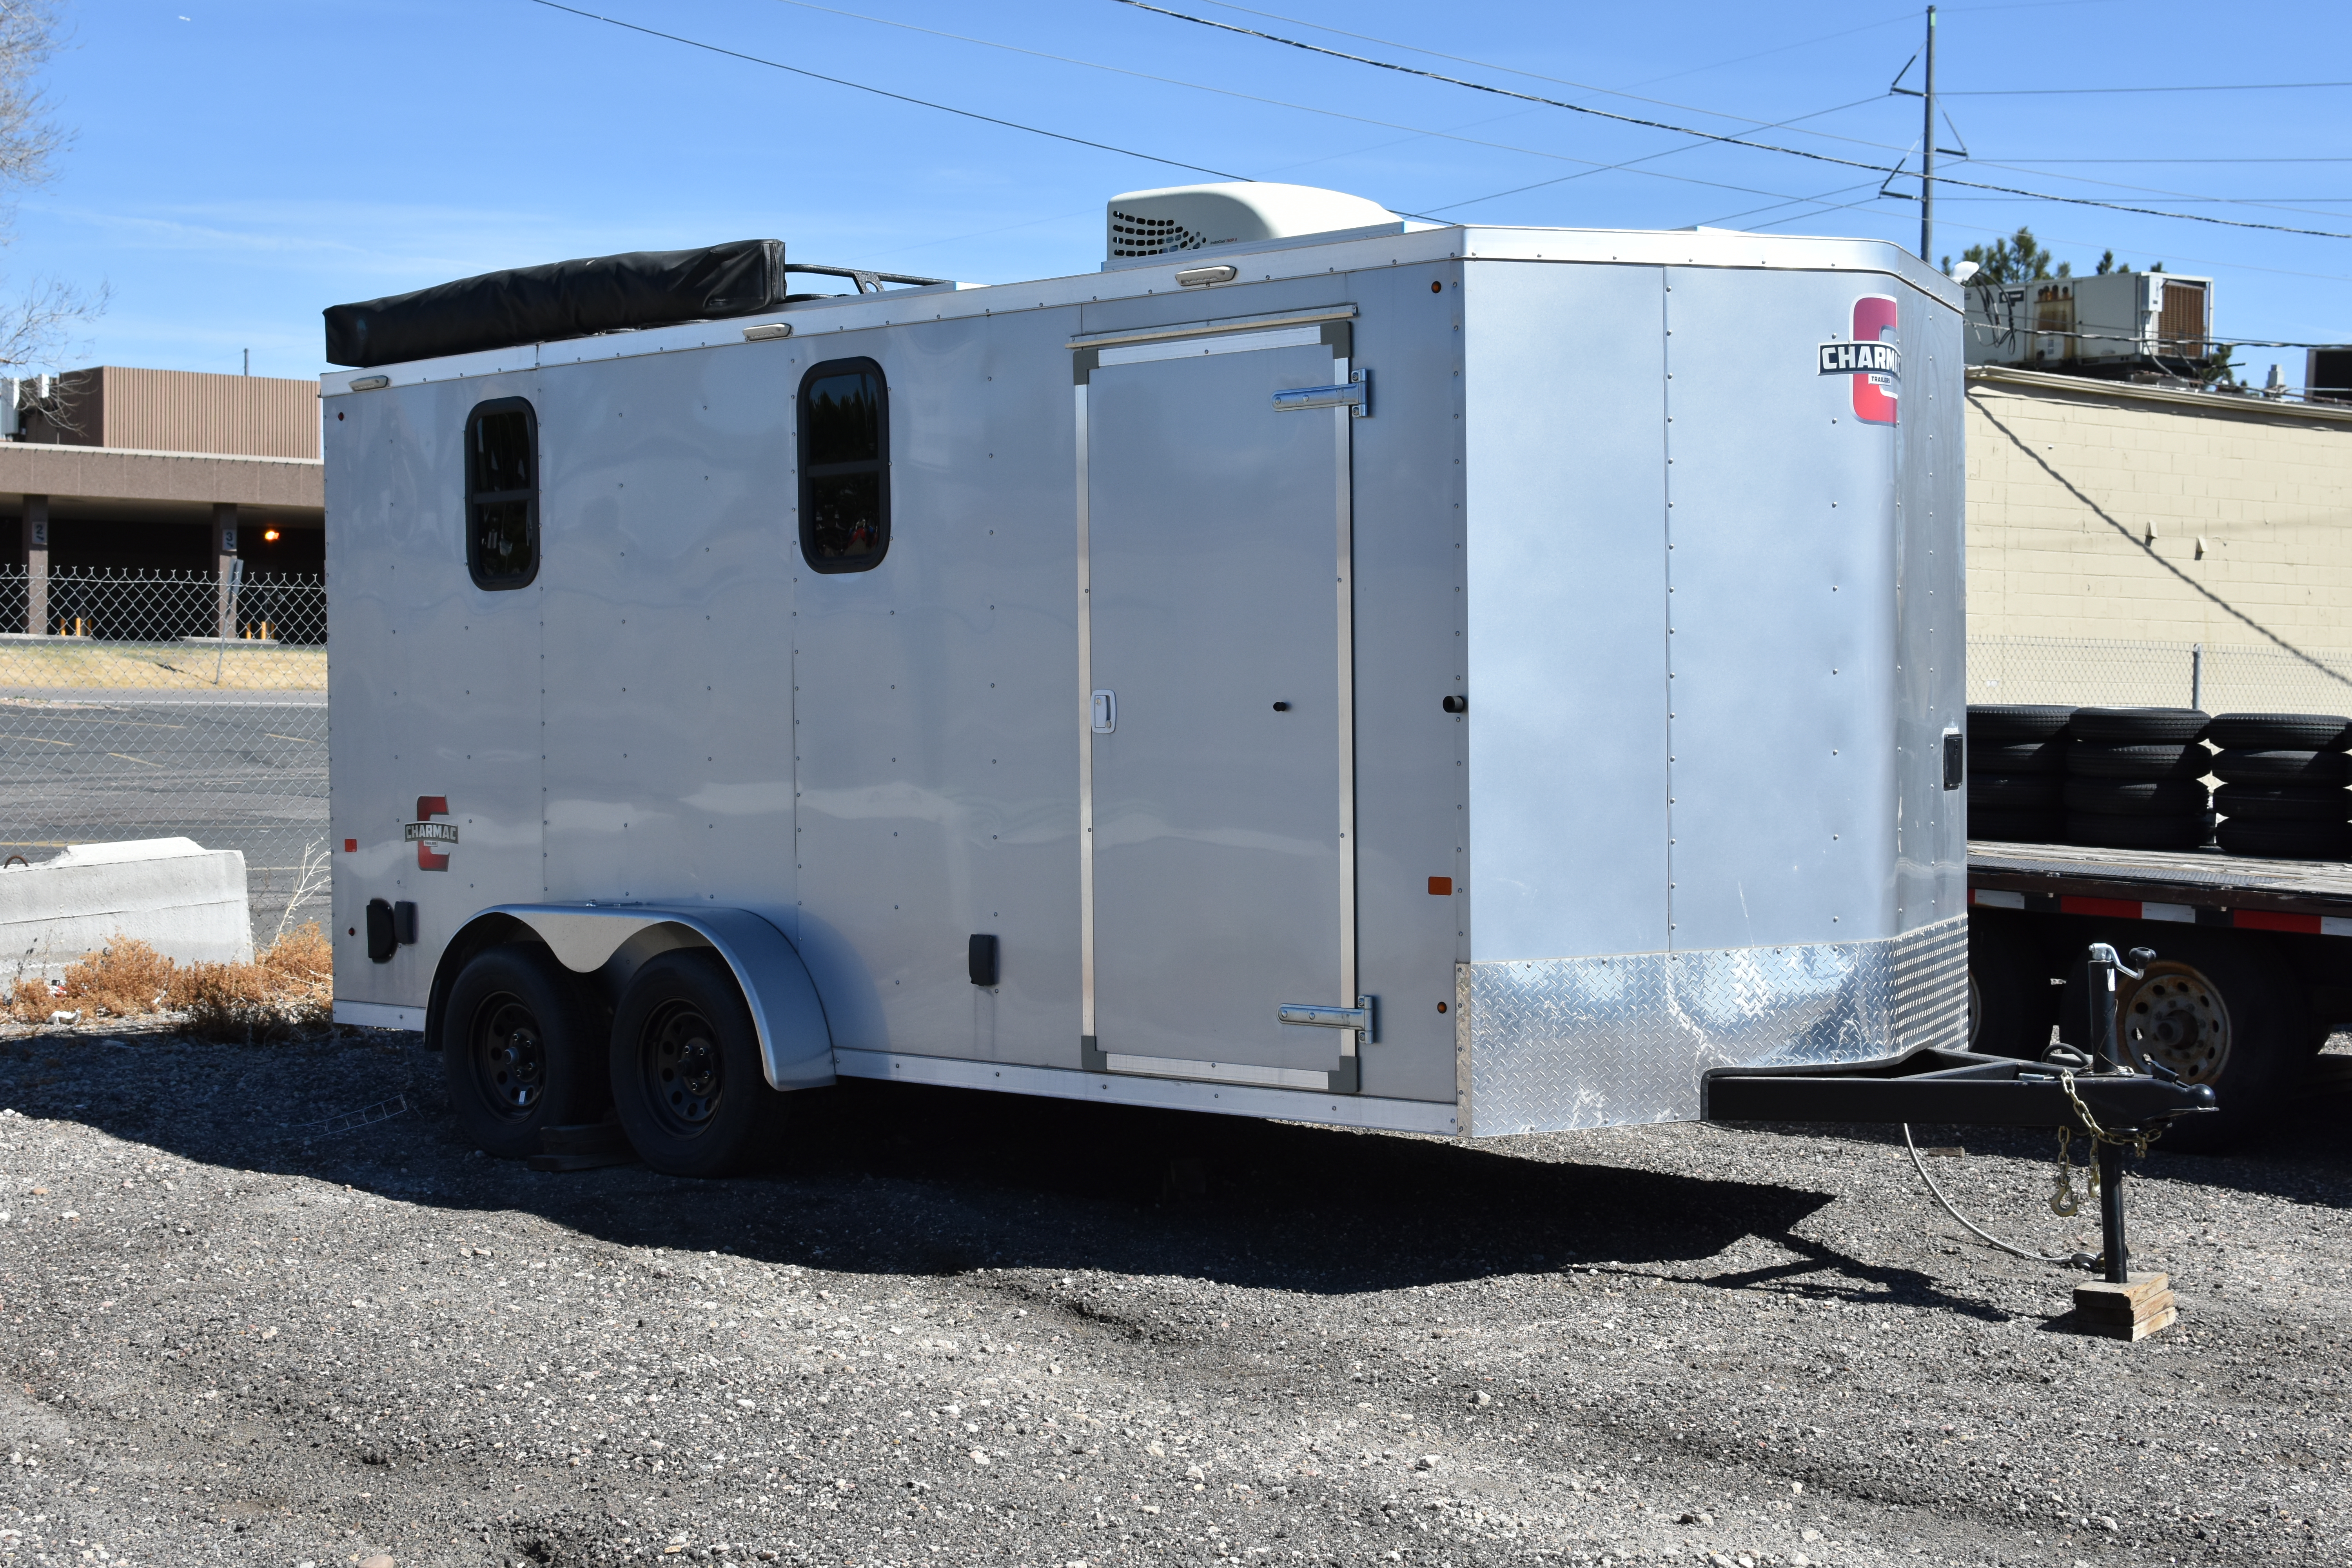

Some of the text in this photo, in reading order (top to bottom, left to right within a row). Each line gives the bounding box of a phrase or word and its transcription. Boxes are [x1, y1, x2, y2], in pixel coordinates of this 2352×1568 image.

[1822, 346, 1900, 378] CHARMAC
[36, 524, 44, 534] 2
[226, 532, 233, 541] 3
[405, 824, 457, 840] CHARMAC
